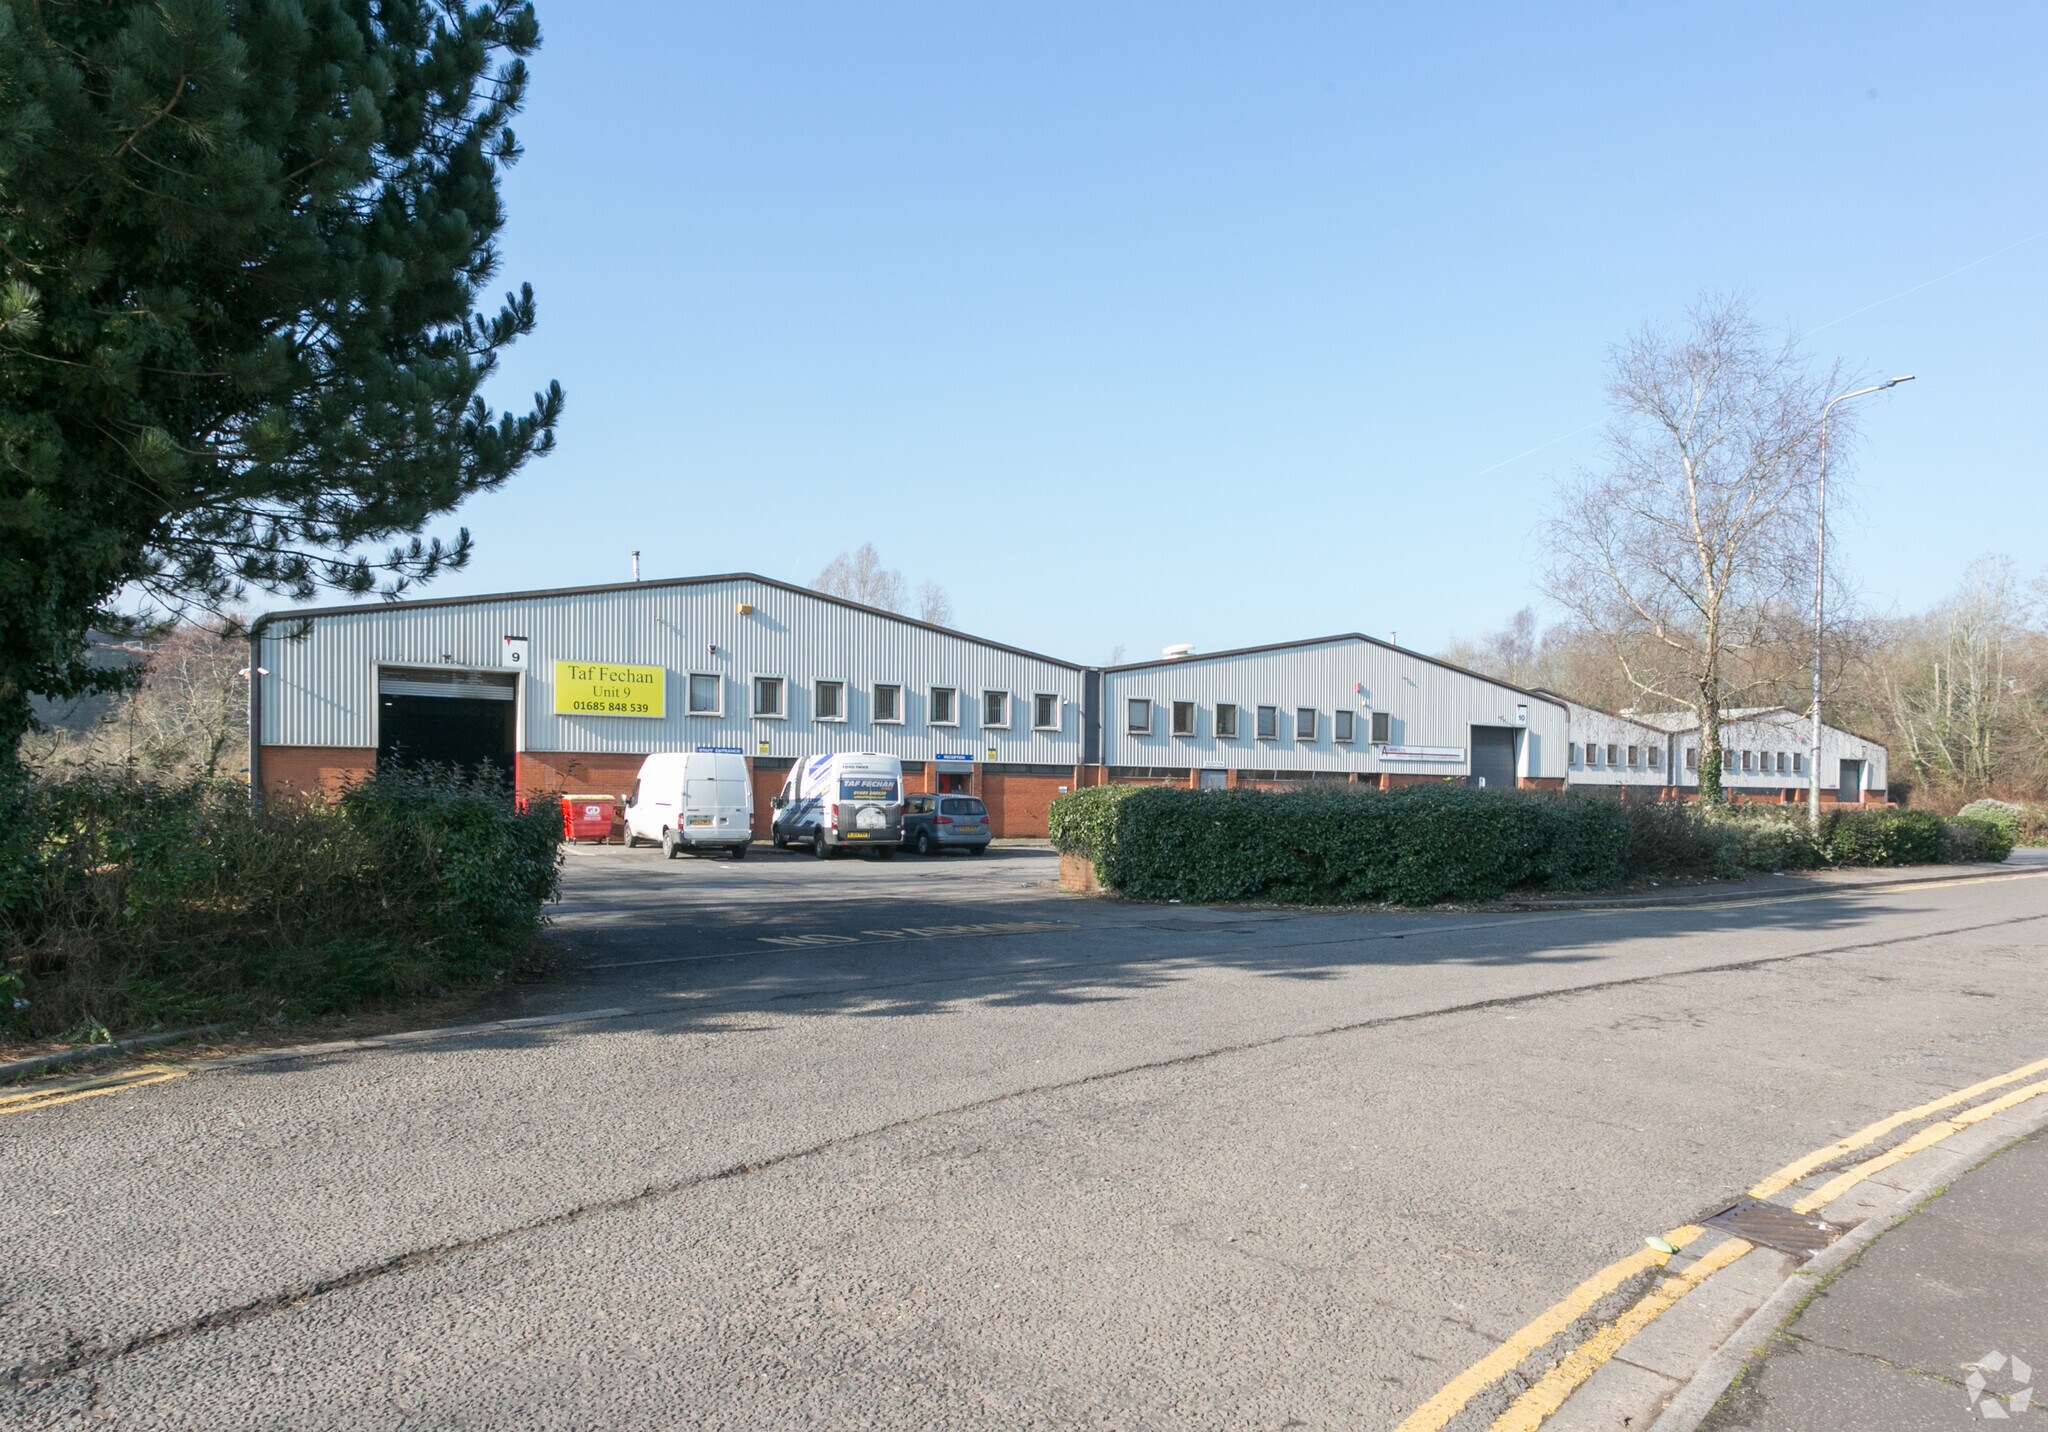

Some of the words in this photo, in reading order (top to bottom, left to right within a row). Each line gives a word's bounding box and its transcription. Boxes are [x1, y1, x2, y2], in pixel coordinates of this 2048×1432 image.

[512, 652, 520, 662] 9
[568, 665, 596, 681] Taf
[600, 667, 653, 684] Fechan
[593, 685, 620, 698] Unit
[623, 687, 631, 698] 9
[573, 701, 605, 711] 01685
[608, 702, 627, 712] 848
[630, 703, 649, 713] 539
[844, 780, 861, 788] TAF
[757, 933, 860, 946] NO
